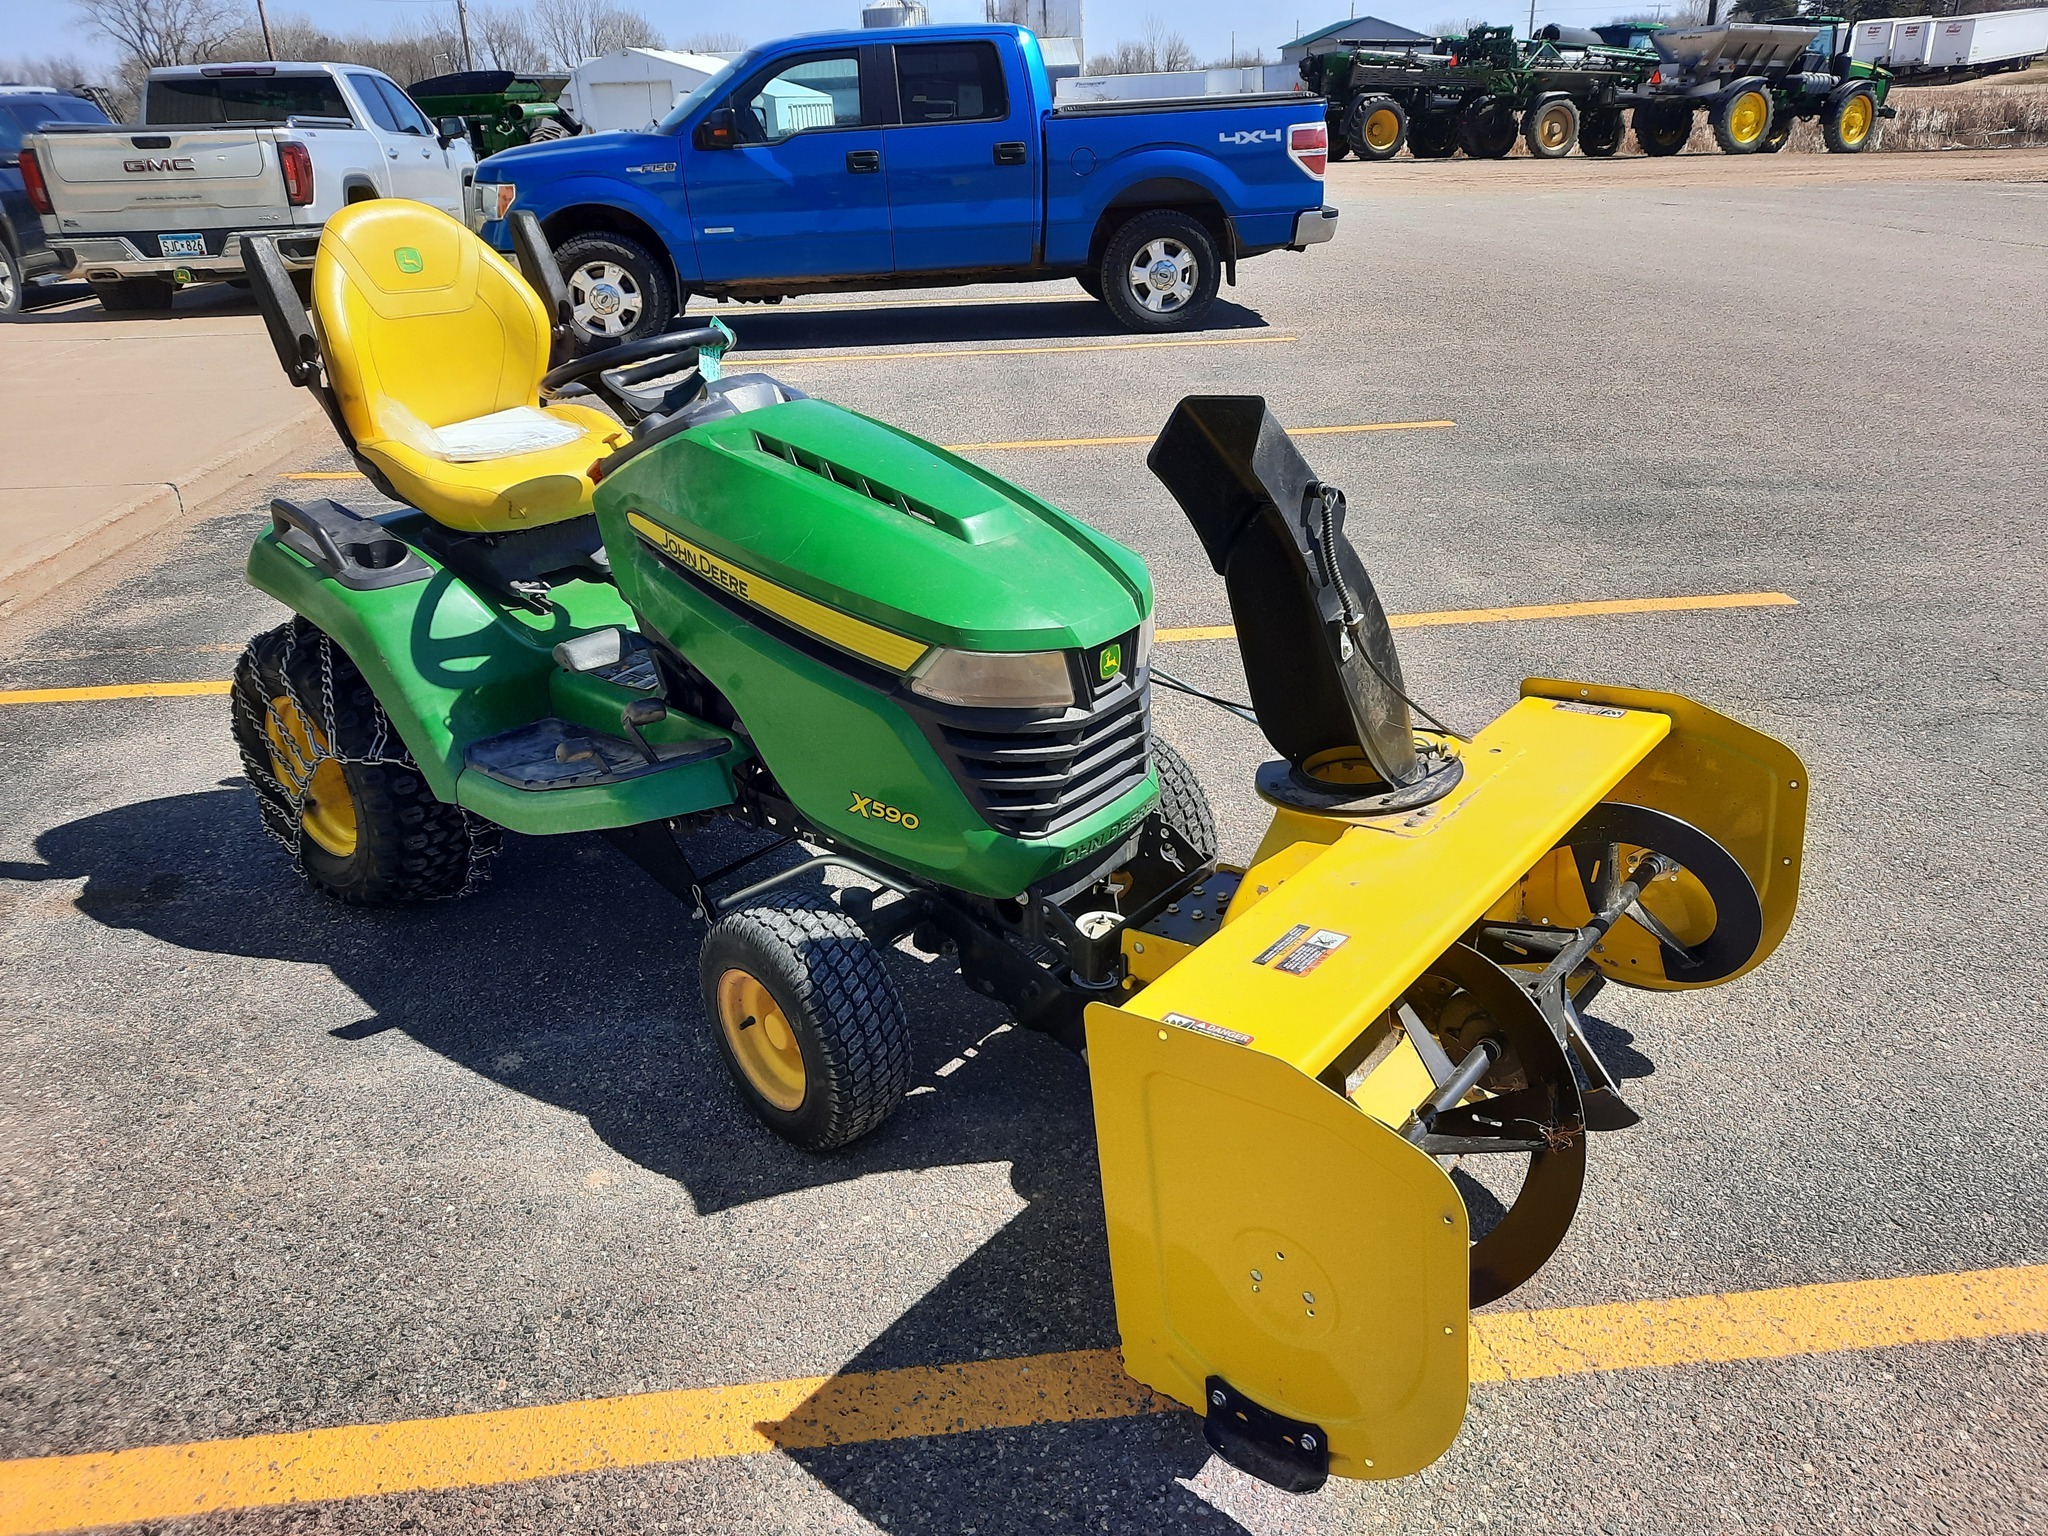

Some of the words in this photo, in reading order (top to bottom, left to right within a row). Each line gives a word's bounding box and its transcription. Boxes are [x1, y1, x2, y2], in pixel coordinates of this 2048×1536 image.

[122, 156, 196, 173] GMC
[661, 532, 697, 568] JOHN
[699, 553, 749, 599] DEERE
[846, 791, 920, 830] X590
[1206, 1024, 1251, 1042] DANGER
